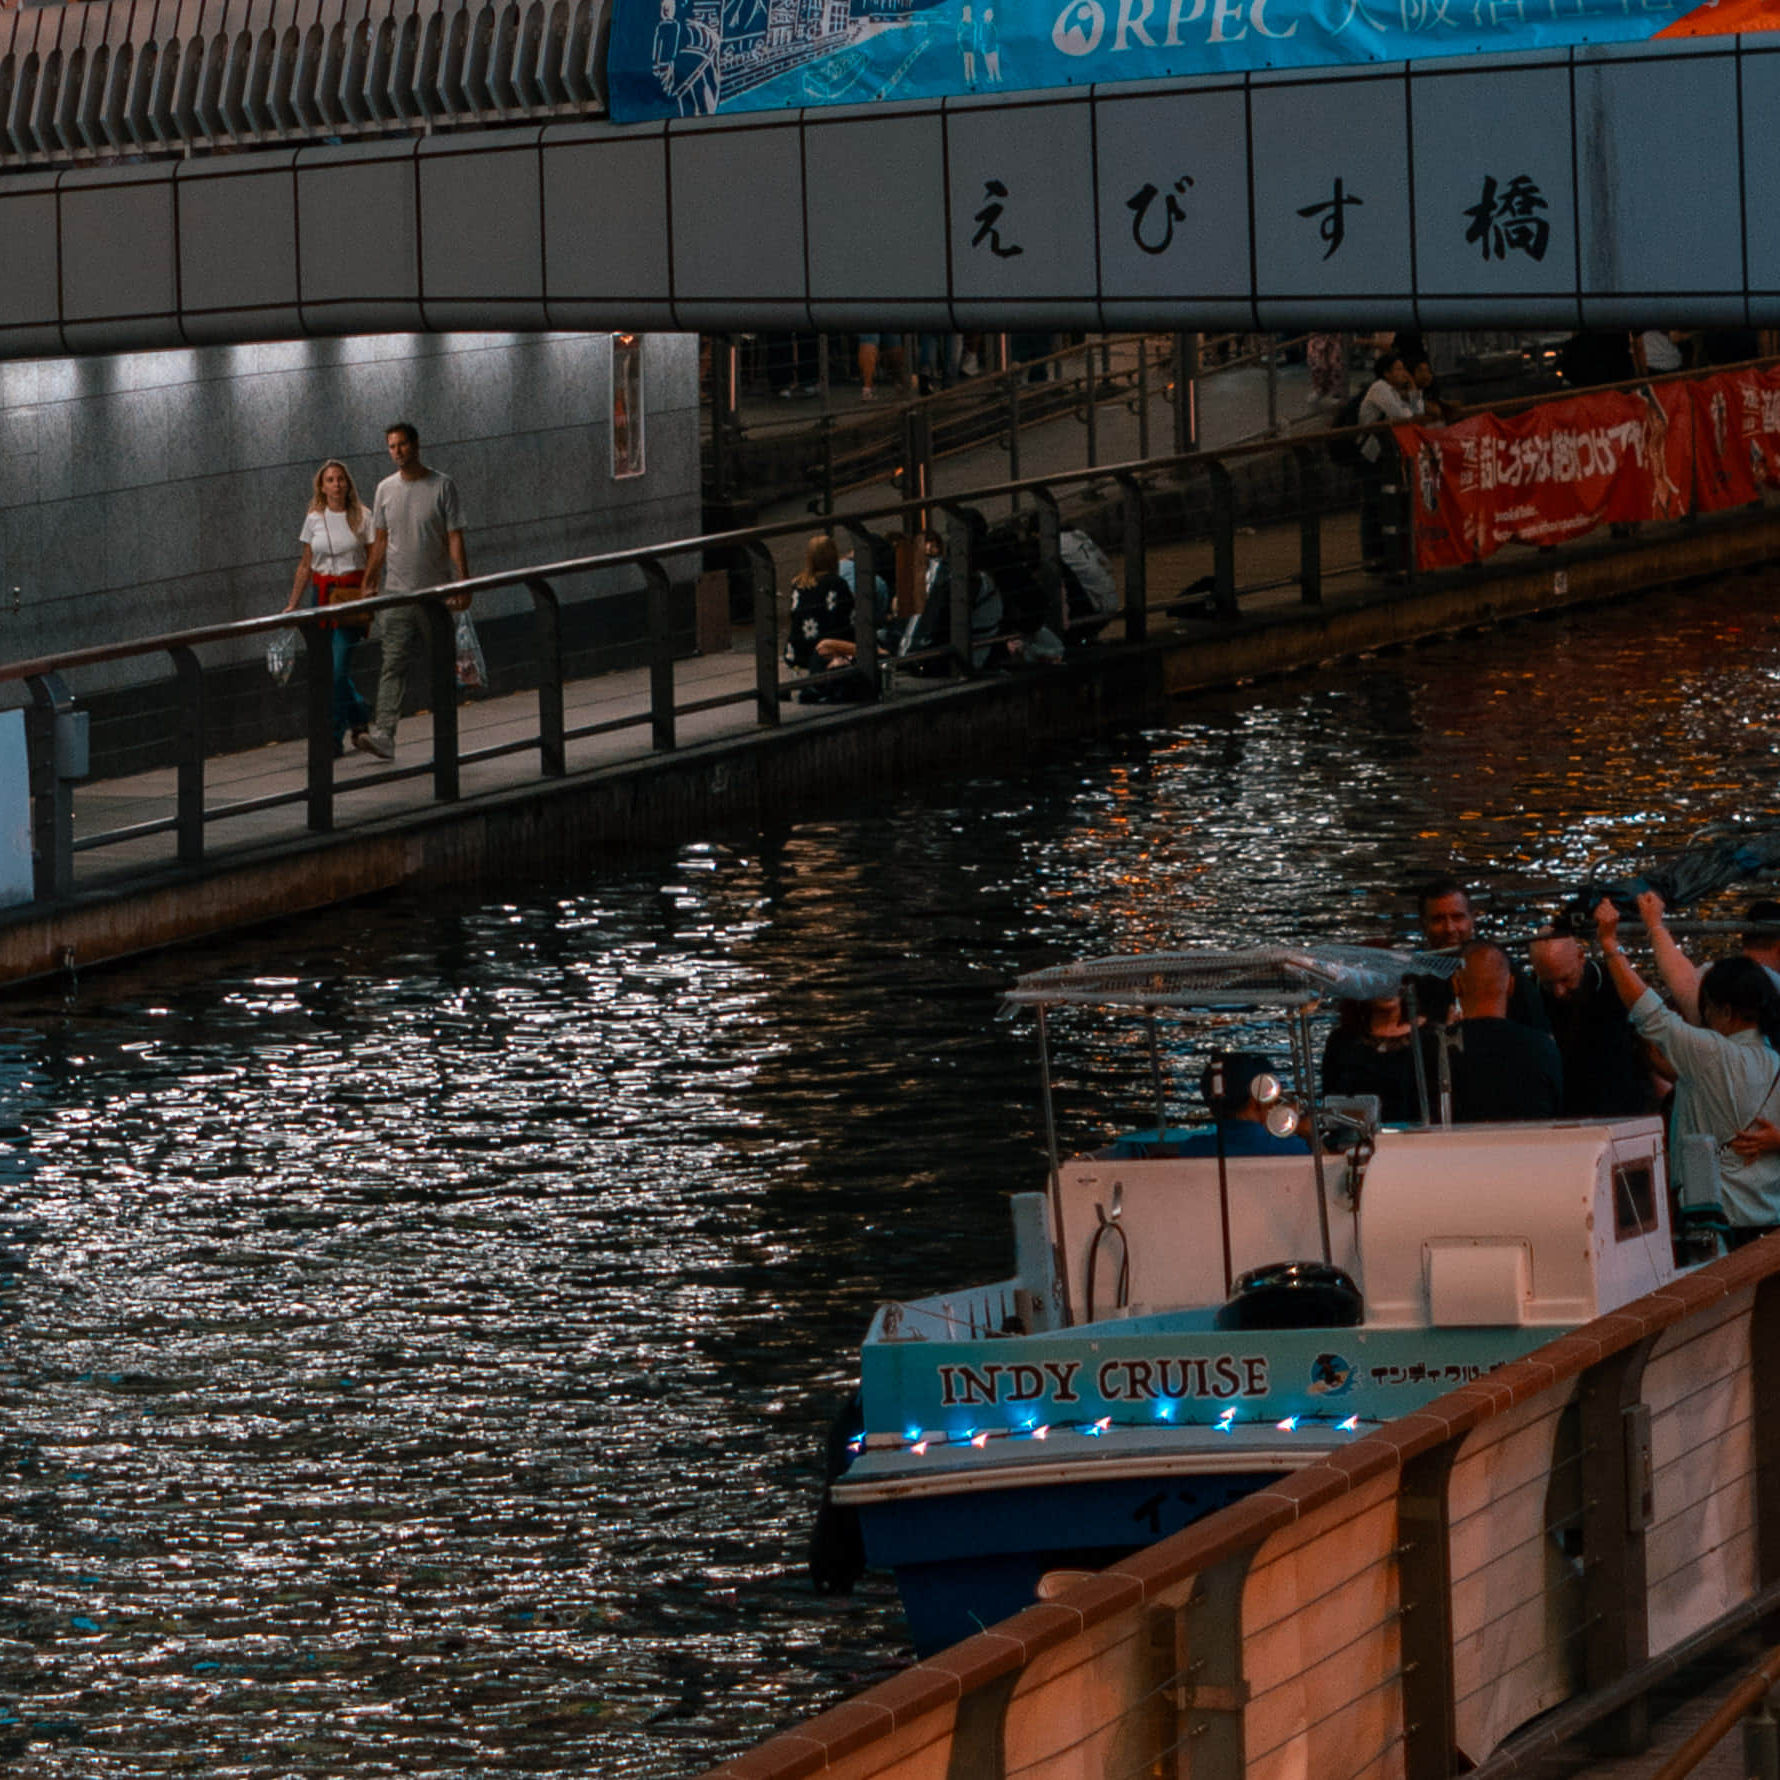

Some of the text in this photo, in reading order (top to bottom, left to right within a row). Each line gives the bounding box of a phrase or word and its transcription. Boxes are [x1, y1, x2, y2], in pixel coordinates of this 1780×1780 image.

[970, 173, 1553, 263] えびす橋
[939, 1354, 1271, 1407] INDY CRUISE
